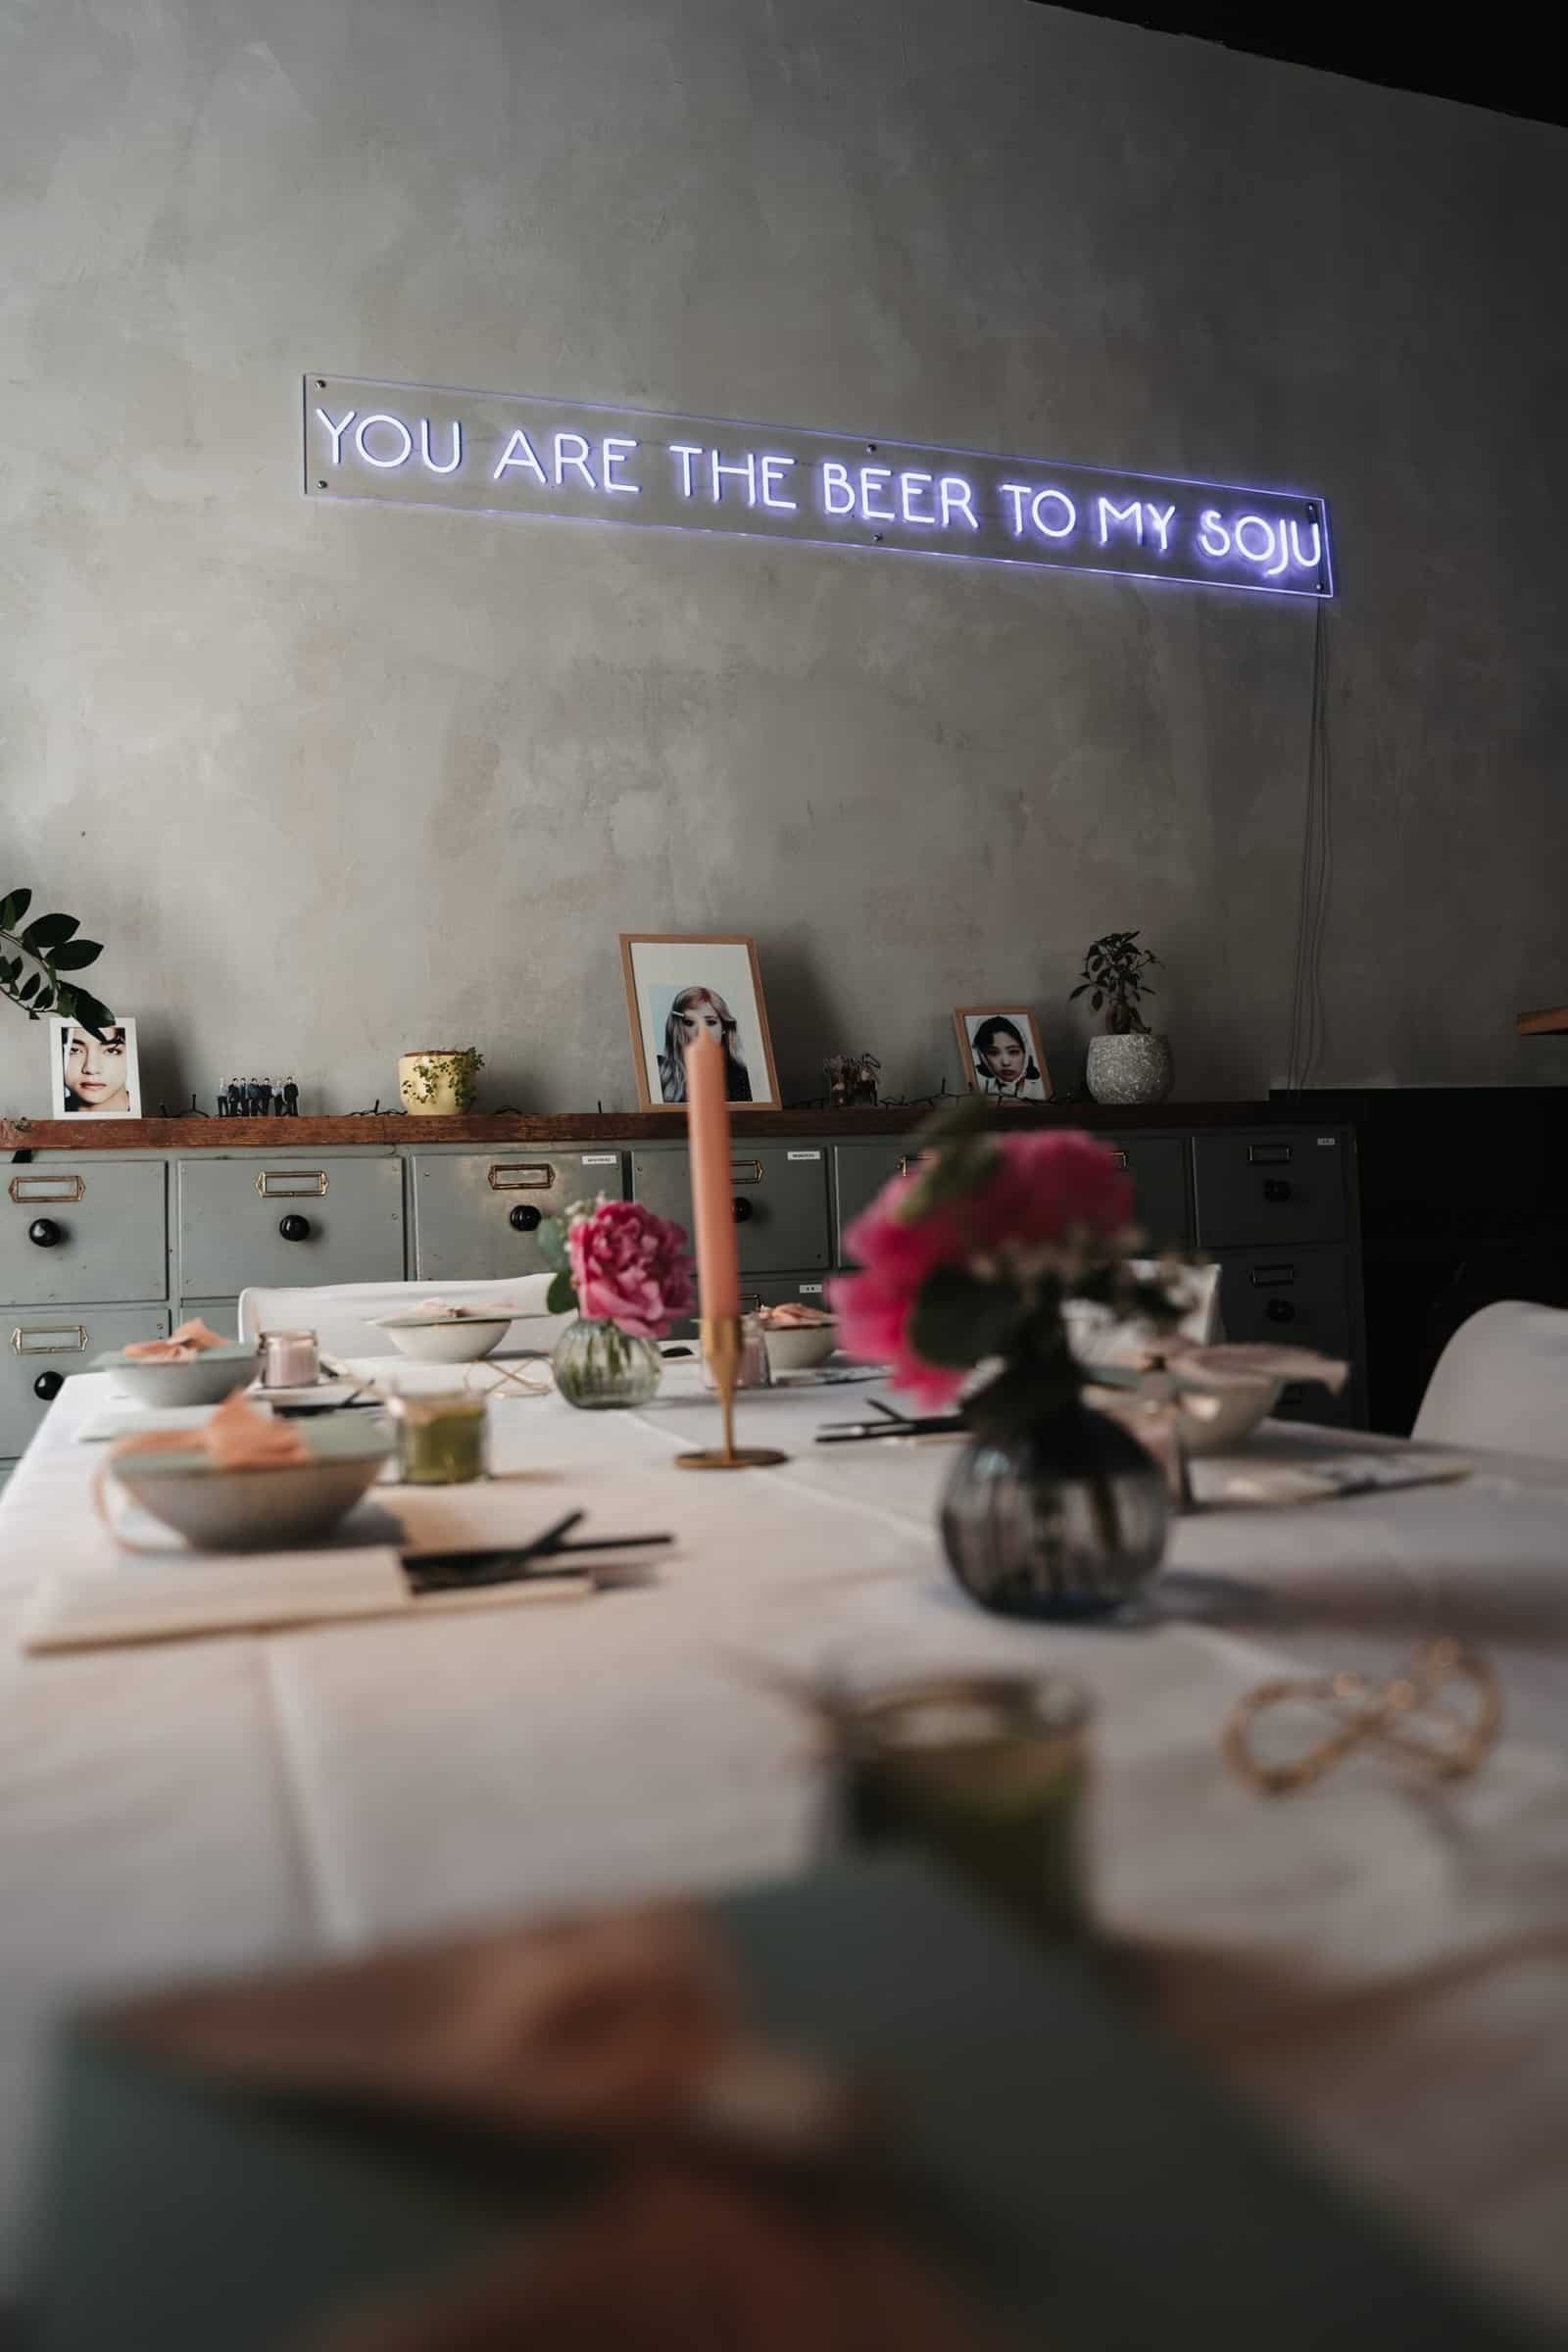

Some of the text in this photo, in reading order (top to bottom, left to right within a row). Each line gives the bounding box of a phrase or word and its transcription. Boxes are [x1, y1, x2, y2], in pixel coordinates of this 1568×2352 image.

[316, 408, 1322, 576] YOU ARE THE BEER TO MY SOJU
